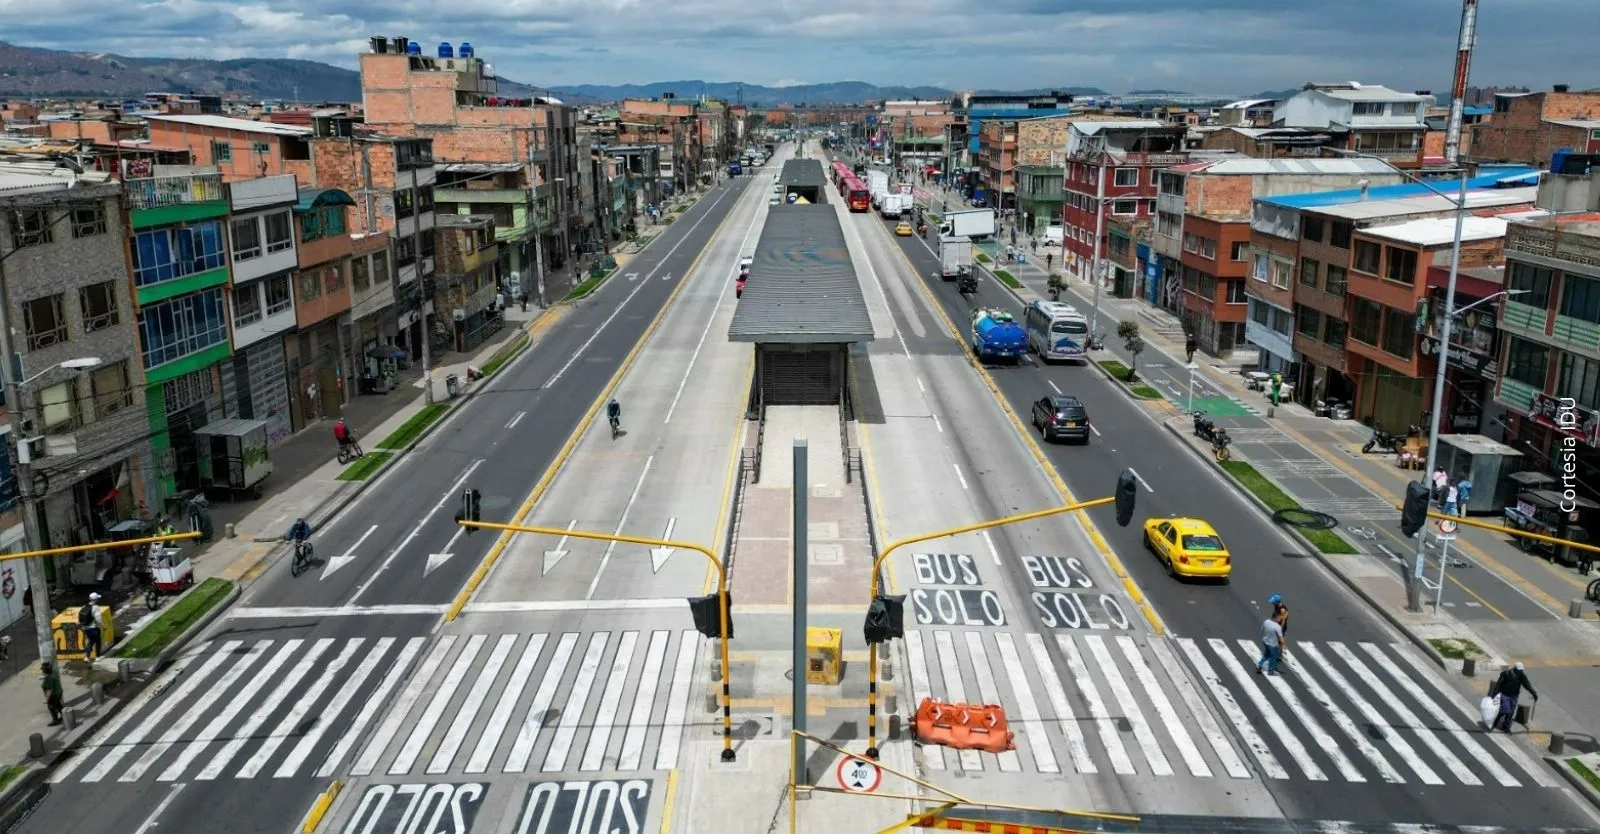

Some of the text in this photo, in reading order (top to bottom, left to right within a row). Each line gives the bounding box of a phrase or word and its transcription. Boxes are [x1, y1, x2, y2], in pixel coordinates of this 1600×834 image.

[912, 553, 978, 585] BUS
[1020, 556, 1093, 588] BUS
[912, 589, 1005, 626] SOLO
[1031, 592, 1129, 630] SOLO
